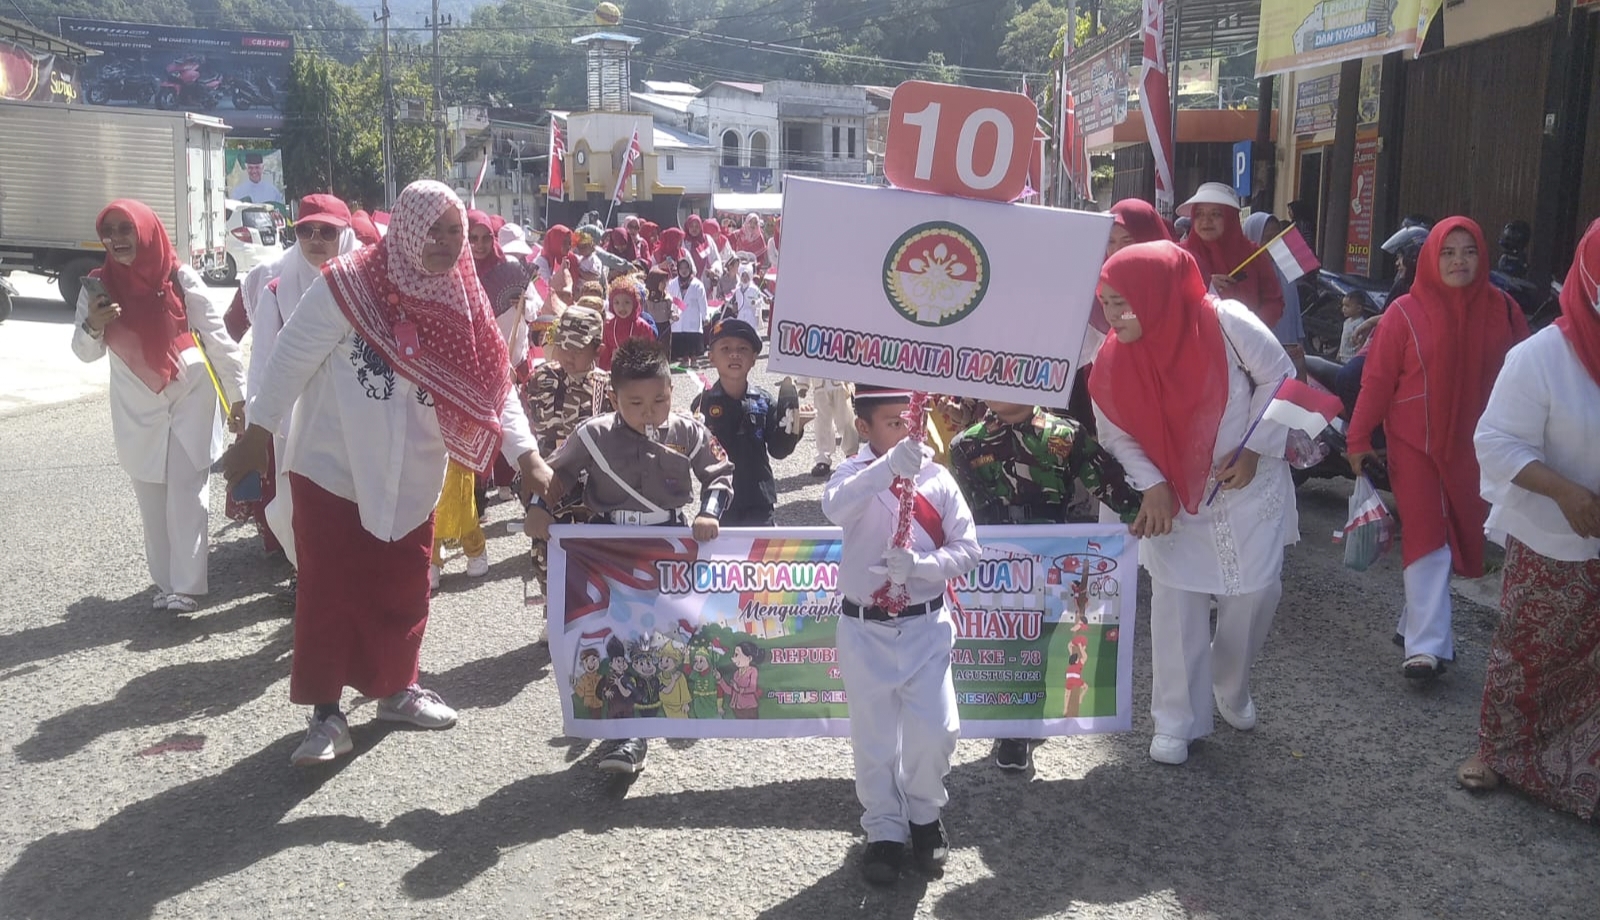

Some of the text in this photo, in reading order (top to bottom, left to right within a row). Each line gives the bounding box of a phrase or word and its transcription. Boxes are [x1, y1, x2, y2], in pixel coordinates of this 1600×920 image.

[268, 40, 286, 48] TYPE
[1315, 22, 1376, 47] DAN NYAMAN
[903, 101, 1014, 190] 10
[1236, 151, 1246, 188] P
[1348, 244, 1369, 255] biro
[778, 320, 1070, 392] TK DHARMAWANITA TAPAKTUAN
[655, 560, 690, 594] TK
[977, 649, 1006, 666] KE
[1020, 650, 1042, 666] 78
[954, 669, 1013, 681] AGUSTUS
[1014, 670, 1042, 681] 2023
